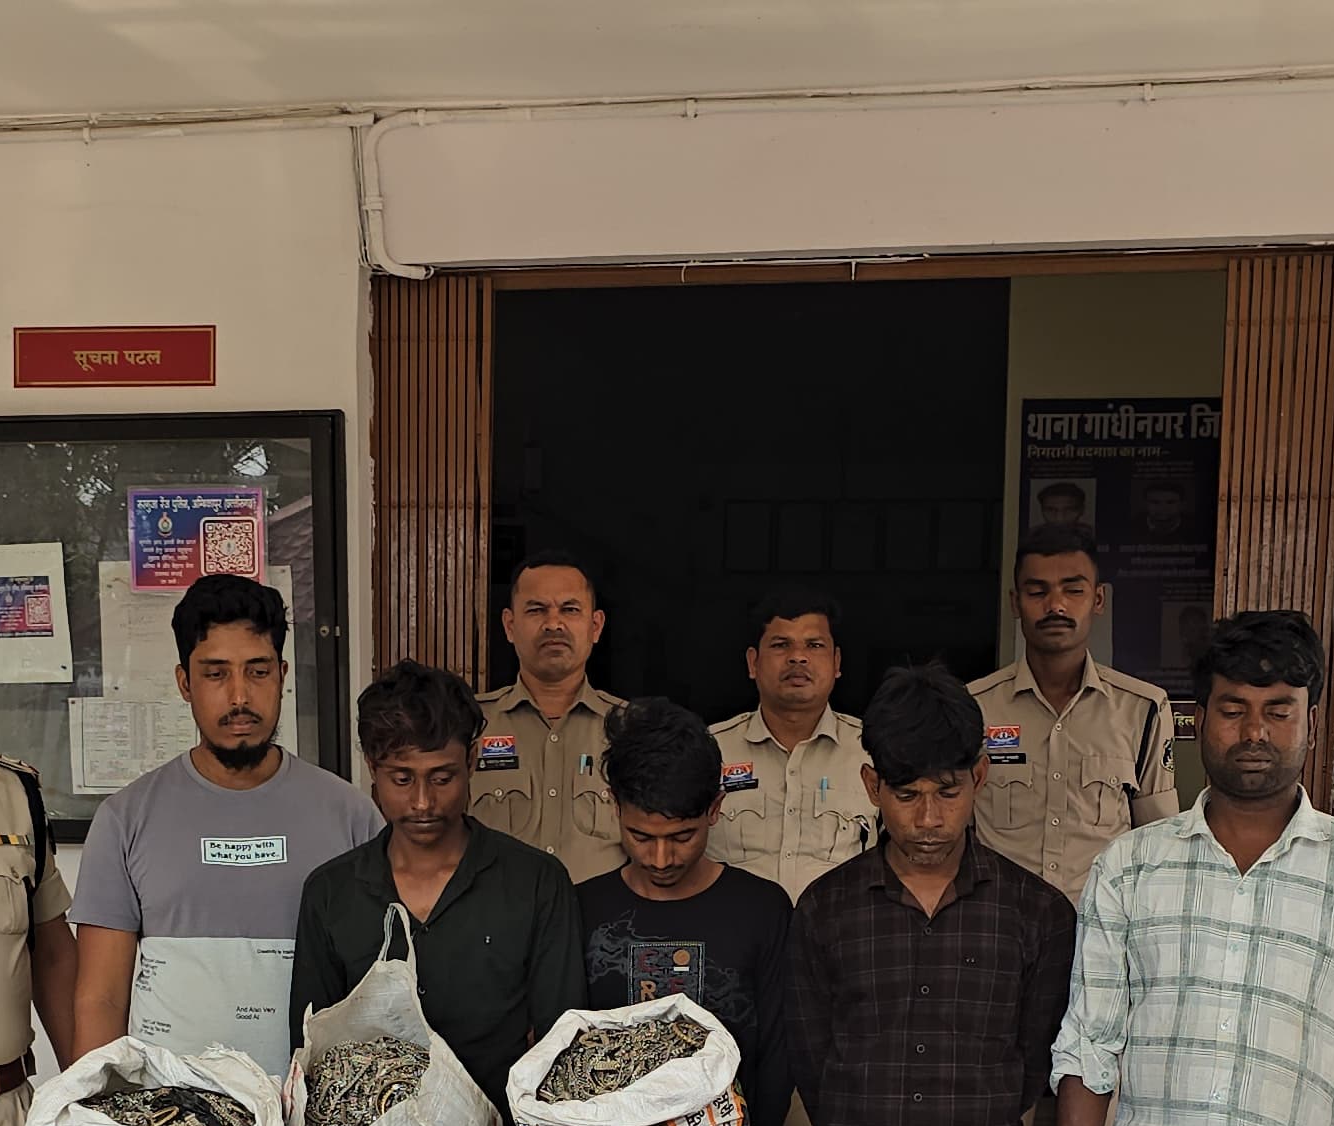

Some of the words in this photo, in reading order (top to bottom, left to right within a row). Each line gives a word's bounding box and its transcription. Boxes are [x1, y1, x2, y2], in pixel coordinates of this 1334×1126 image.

[73, 351, 119, 371] सूचना
[123, 350, 161, 365] पटल
[1027, 414, 1081, 440] थाना
[1083, 403, 1187, 440] गांधीनगर
[1191, 404, 1221, 438] जि
